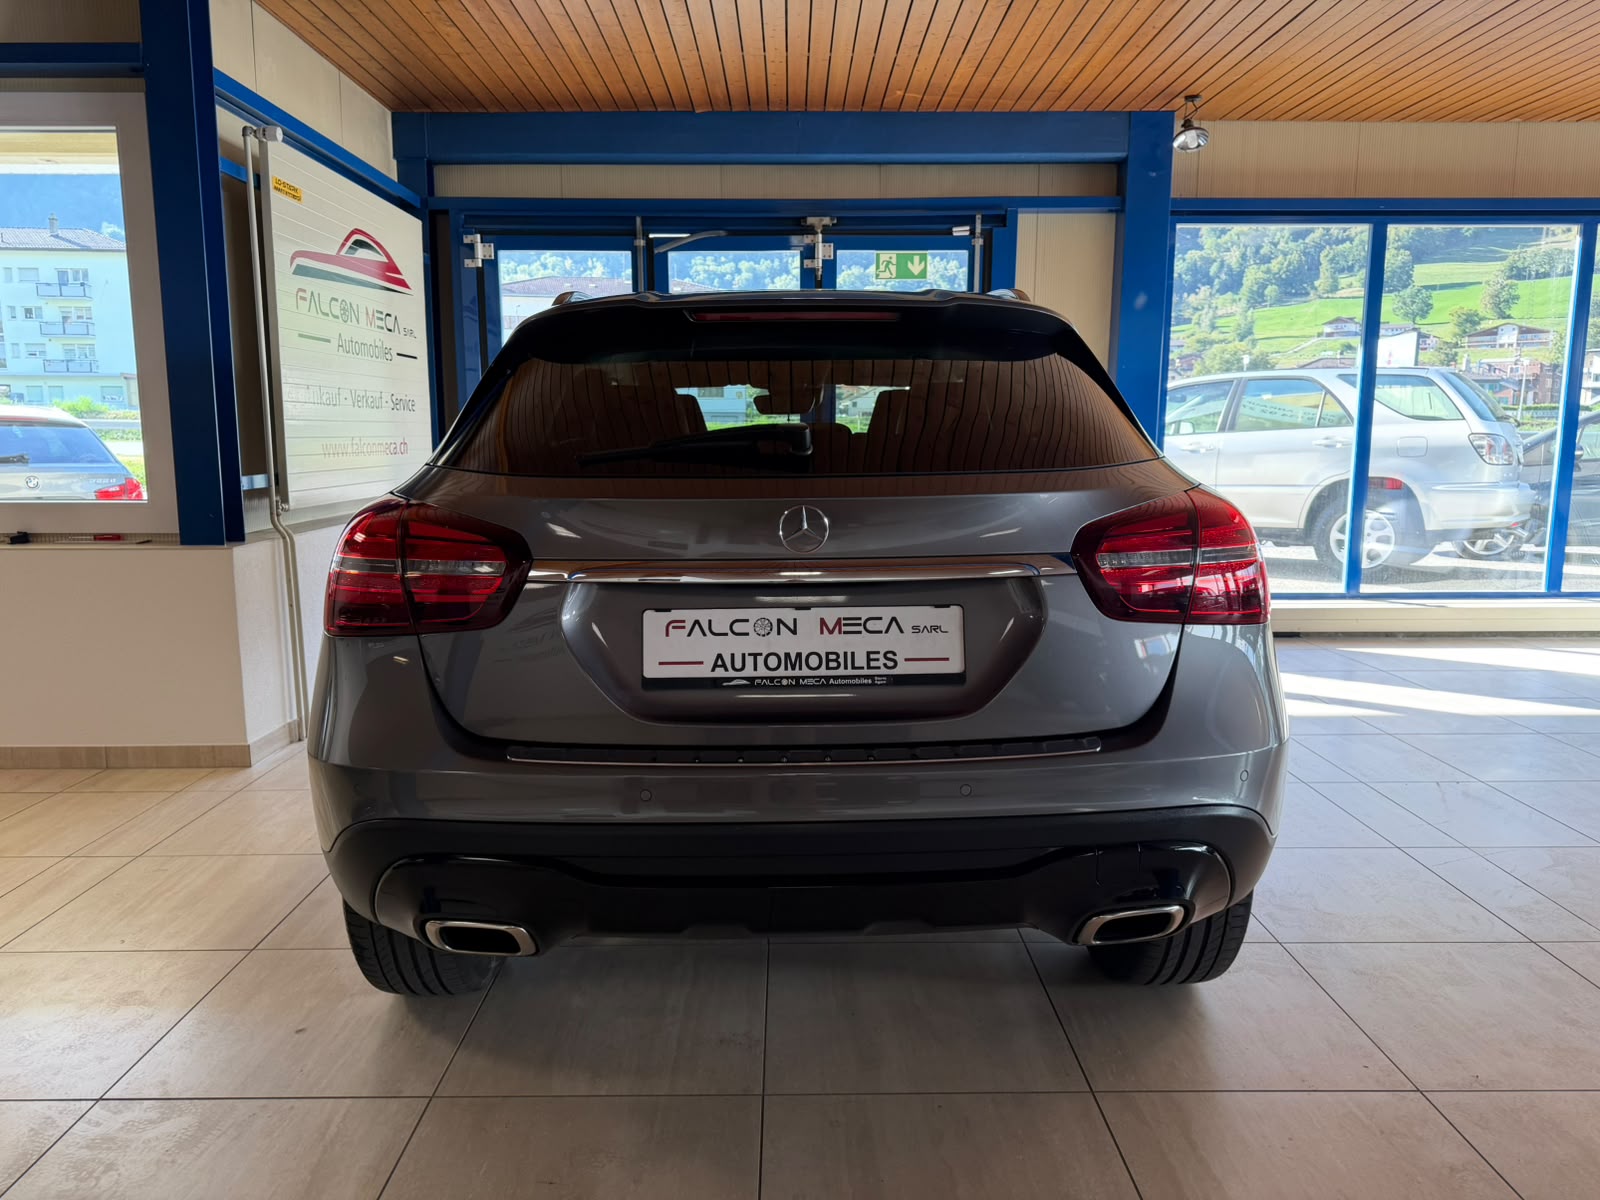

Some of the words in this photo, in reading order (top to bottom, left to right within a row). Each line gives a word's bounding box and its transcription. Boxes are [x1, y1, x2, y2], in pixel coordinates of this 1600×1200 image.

[295, 287, 360, 325] FALCON
[365, 306, 401, 335] MECA
[337, 332, 393, 361] Automobiles
[349, 388, 383, 410] Verkauf
[390, 393, 416, 412] Service
[321, 437, 408, 459] www.falconmeca.ch
[665, 617, 797, 638] FALCON
[819, 616, 904, 635] MECA
[911, 625, 949, 634] SARL
[710, 650, 899, 673] AUTOMOBILES
[754, 678, 796, 687] FALCON
[799, 678, 827, 686] MECA
[829, 677, 872, 686] Automobiles
